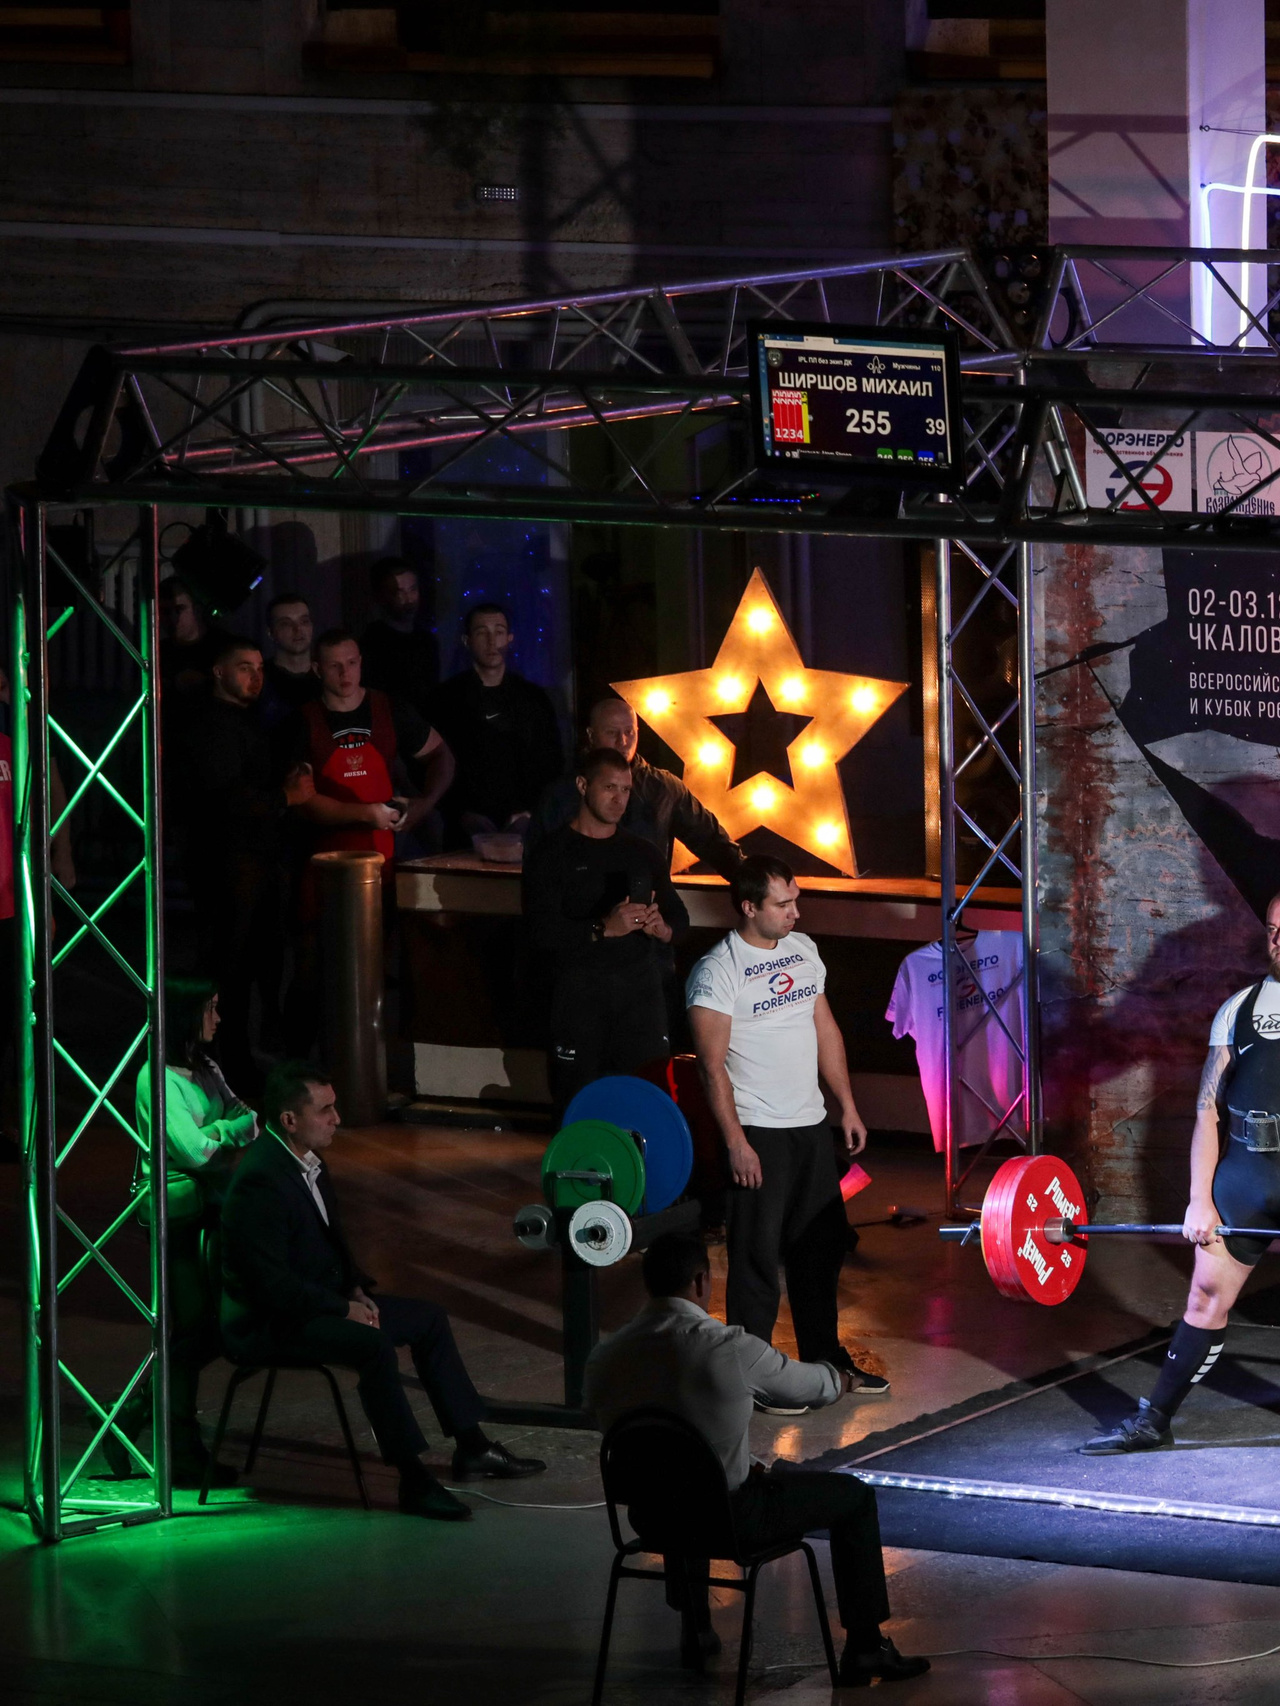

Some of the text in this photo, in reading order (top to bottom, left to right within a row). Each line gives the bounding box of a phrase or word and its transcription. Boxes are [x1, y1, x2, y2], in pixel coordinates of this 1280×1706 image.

[892, 362, 921, 371] Мужчины
[778, 372, 933, 398] ШИРШОВ МИХАИЛ
[846, 408, 892, 435] 255
[925, 418, 946, 436] 39
[1190, 698, 1198, 714] И
[1204, 699, 1252, 718] КУБОК
[744, 954, 804, 977] ФОРЭНЕРГО
[752, 984, 818, 1014] FORENERGO
[1060, 1249, 1072, 1268] 25
